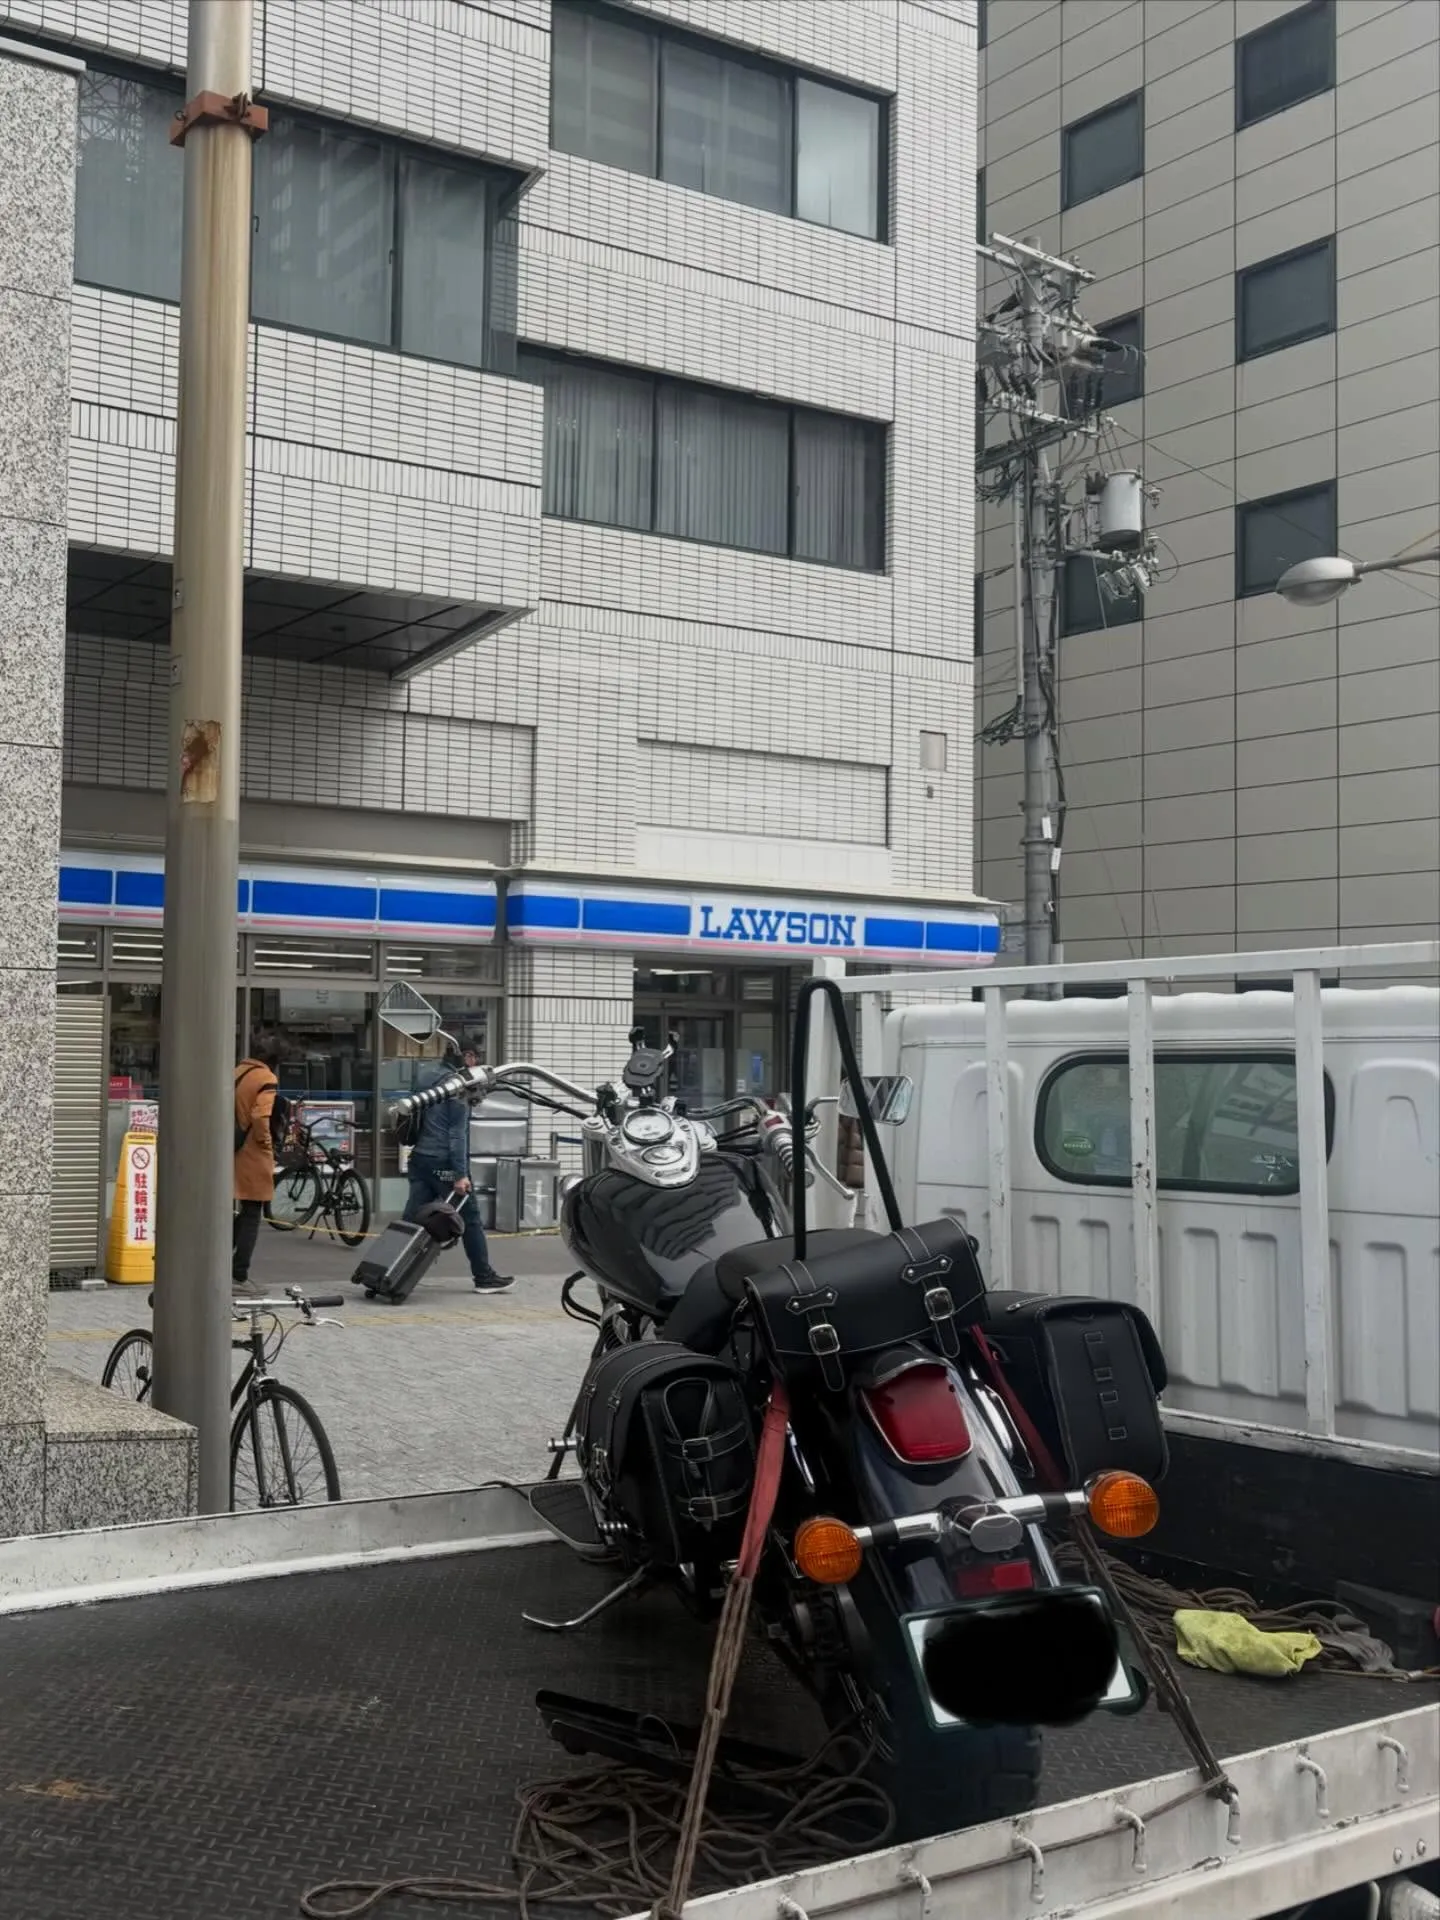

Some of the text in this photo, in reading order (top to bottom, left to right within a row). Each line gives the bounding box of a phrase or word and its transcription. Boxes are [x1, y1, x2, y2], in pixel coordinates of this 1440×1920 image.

[700, 906, 857, 946] LAWSON
[134, 1173, 148, 1241] 駐輪禁止
